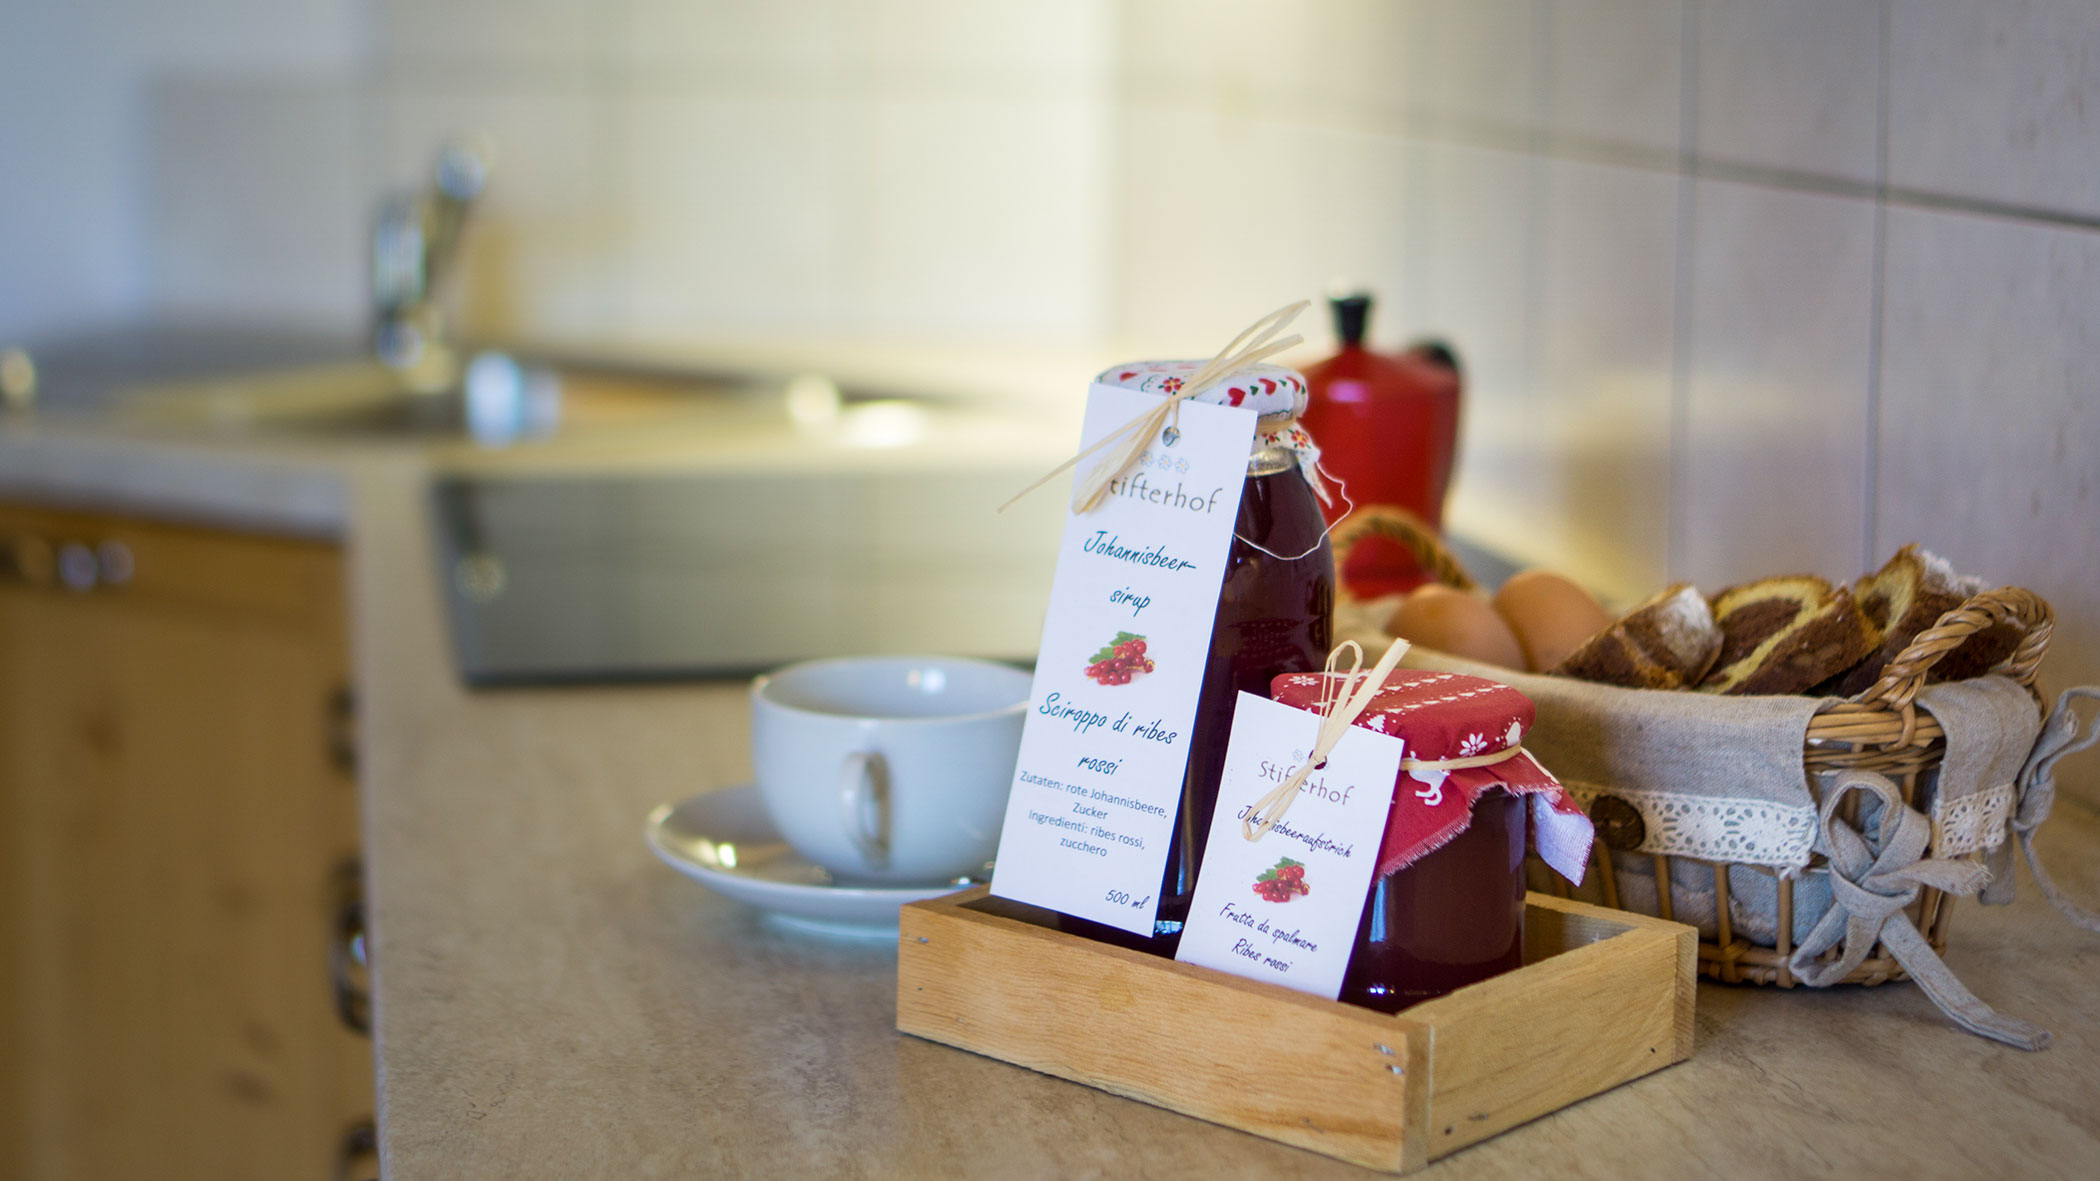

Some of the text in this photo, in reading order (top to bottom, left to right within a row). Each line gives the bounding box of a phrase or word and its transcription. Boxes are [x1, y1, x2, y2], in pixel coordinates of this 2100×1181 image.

[1109, 472, 1223, 513] tifterhof
[1084, 530, 1197, 571] Johannisbeer-
[1110, 587, 1150, 617] sirup
[1039, 692, 1178, 745] Sciroppo di ribes
[1077, 755, 1123, 776] rossi
[1258, 760, 1355, 806] Stiferhof
[1019, 770, 1168, 818] Zutaten: rote Johannisbeere,
[1072, 802, 1108, 821] Zucker
[1028, 809, 1145, 850] Ingredienti: ribes rossi,
[1060, 837, 1107, 857] zucchero
[1105, 889, 1151, 910] 500 ml
[1219, 902, 1318, 953] Frutta da spalmare
[1231, 938, 1262, 961] Ribes
